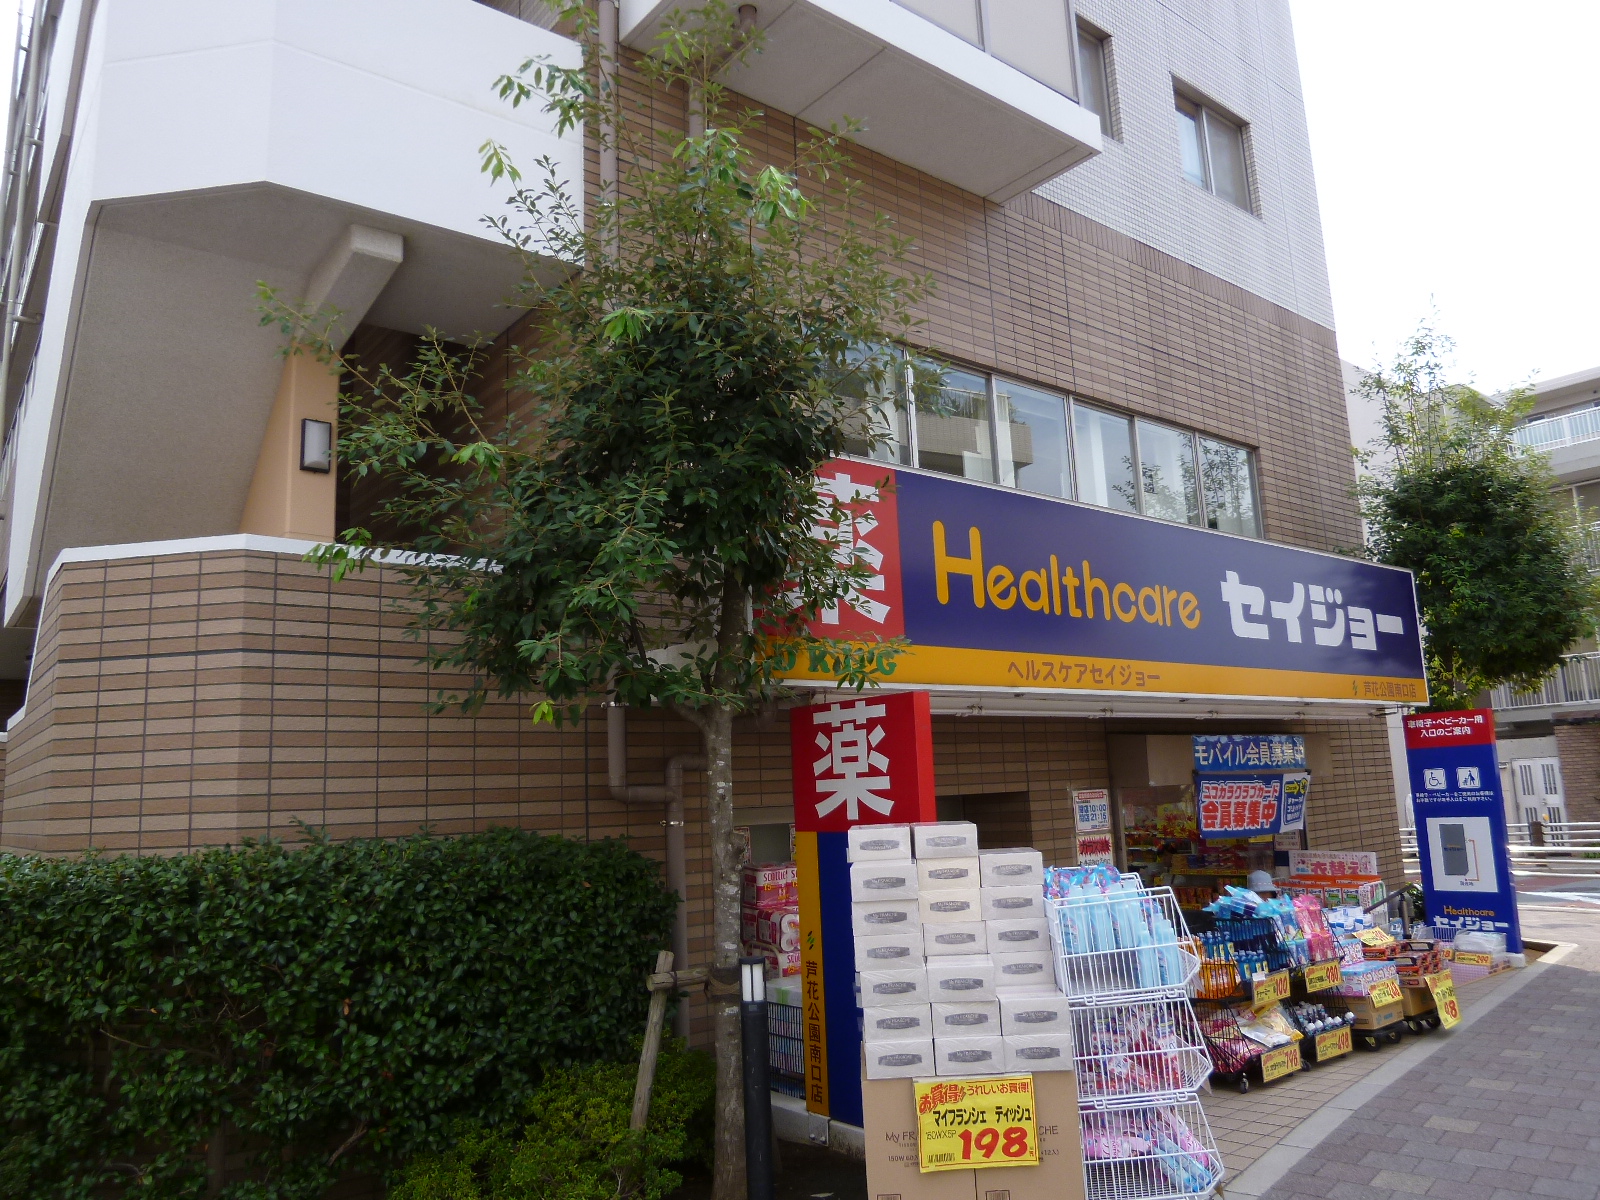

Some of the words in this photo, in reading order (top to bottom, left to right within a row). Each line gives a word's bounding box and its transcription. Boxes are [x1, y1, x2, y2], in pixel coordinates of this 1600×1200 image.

[932, 520, 1201, 630] Healthcare
[1220, 570, 1404, 651] セイジョー
[1007, 659, 1161, 687] ヘルスケアセイジョー
[1362, 679, 1417, 699] 芦花公園南口店
[1407, 714, 1483, 729] 車椅子・ベビーカー用
[1420, 726, 1471, 738] 入口のご案内
[812, 700, 895, 821] 薬
[1194, 741, 1305, 767] モバイル会員募集中
[1201, 800, 1277, 830] 会員募集中
[1443, 905, 1495, 917] Healthcare
[1433, 915, 1509, 931] セイジョー
[1275, 974, 1288, 997] 100
[804, 960, 824, 1106] 芦花公園南口店
[967, 1081, 1030, 1097] うれしいお買得!
[932, 1107, 987, 1127] マイフランシェ
[995, 1104, 1032, 1124] ティッシュ
[885, 1131, 900, 1144] My
[957, 1126, 1029, 1160] 198
